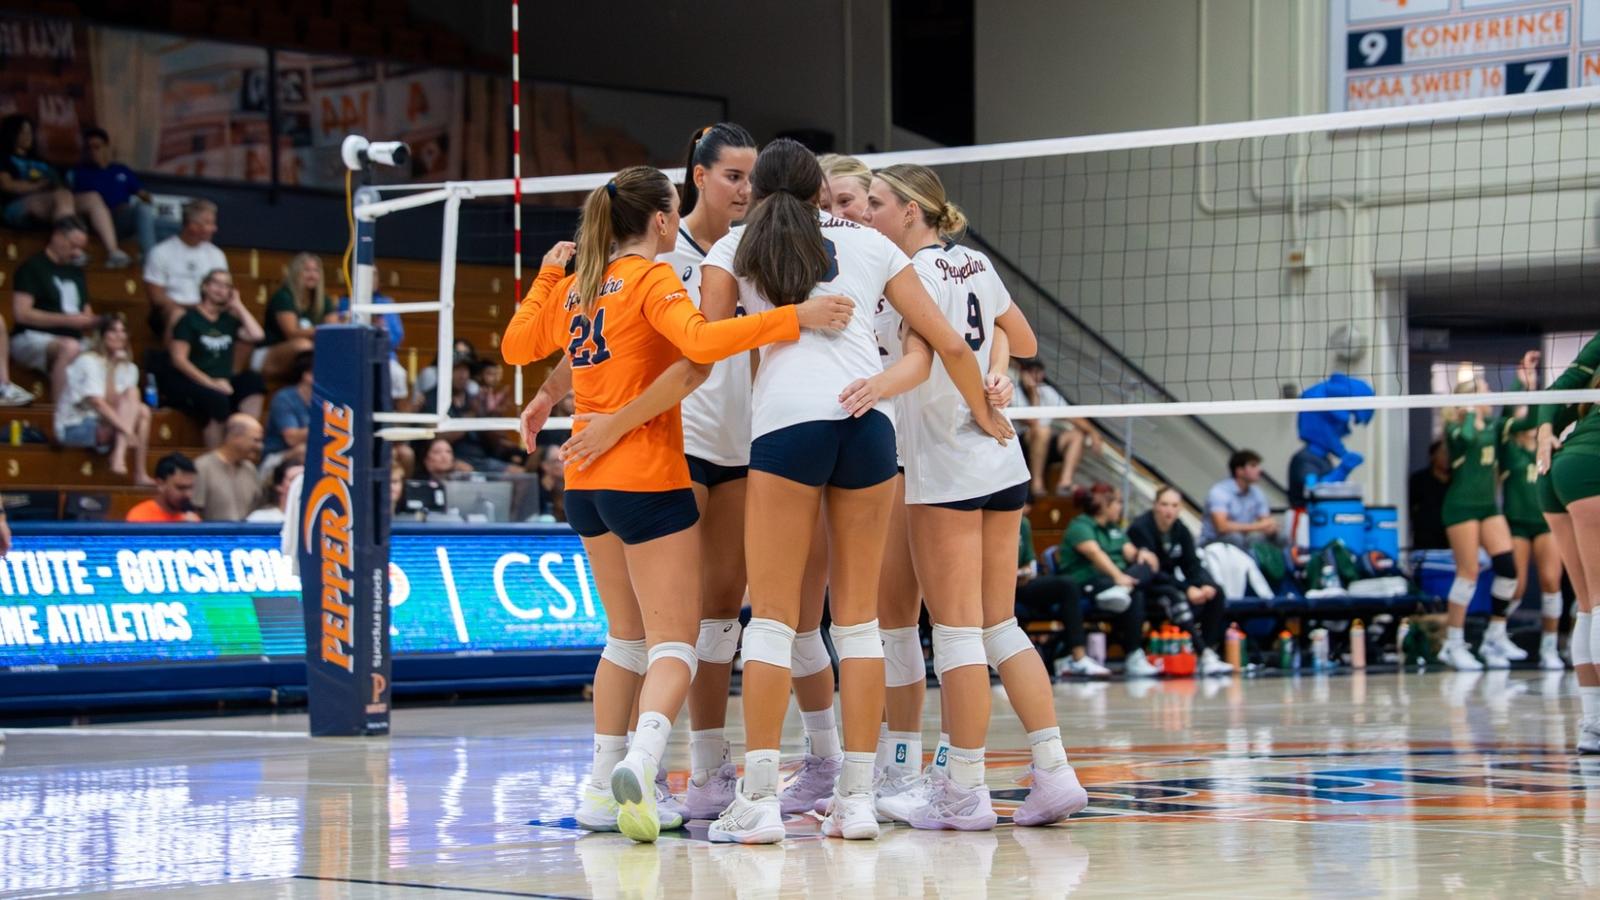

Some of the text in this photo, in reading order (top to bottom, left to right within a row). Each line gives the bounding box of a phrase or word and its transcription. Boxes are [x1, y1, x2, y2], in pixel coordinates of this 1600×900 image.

[1359, 31, 1388, 66] 9
[1405, 10, 1565, 49] CONFERENCE
[1349, 77, 1405, 101] NCAA
[1410, 69, 1472, 97] SWEET
[1523, 61, 1552, 93] 7
[568, 307, 611, 369] 21
[964, 292, 986, 352] 9
[304, 399, 355, 674] PEPPERDINE
[493, 552, 596, 619] CSI
[46, 602, 193, 644] ATHLETICS
